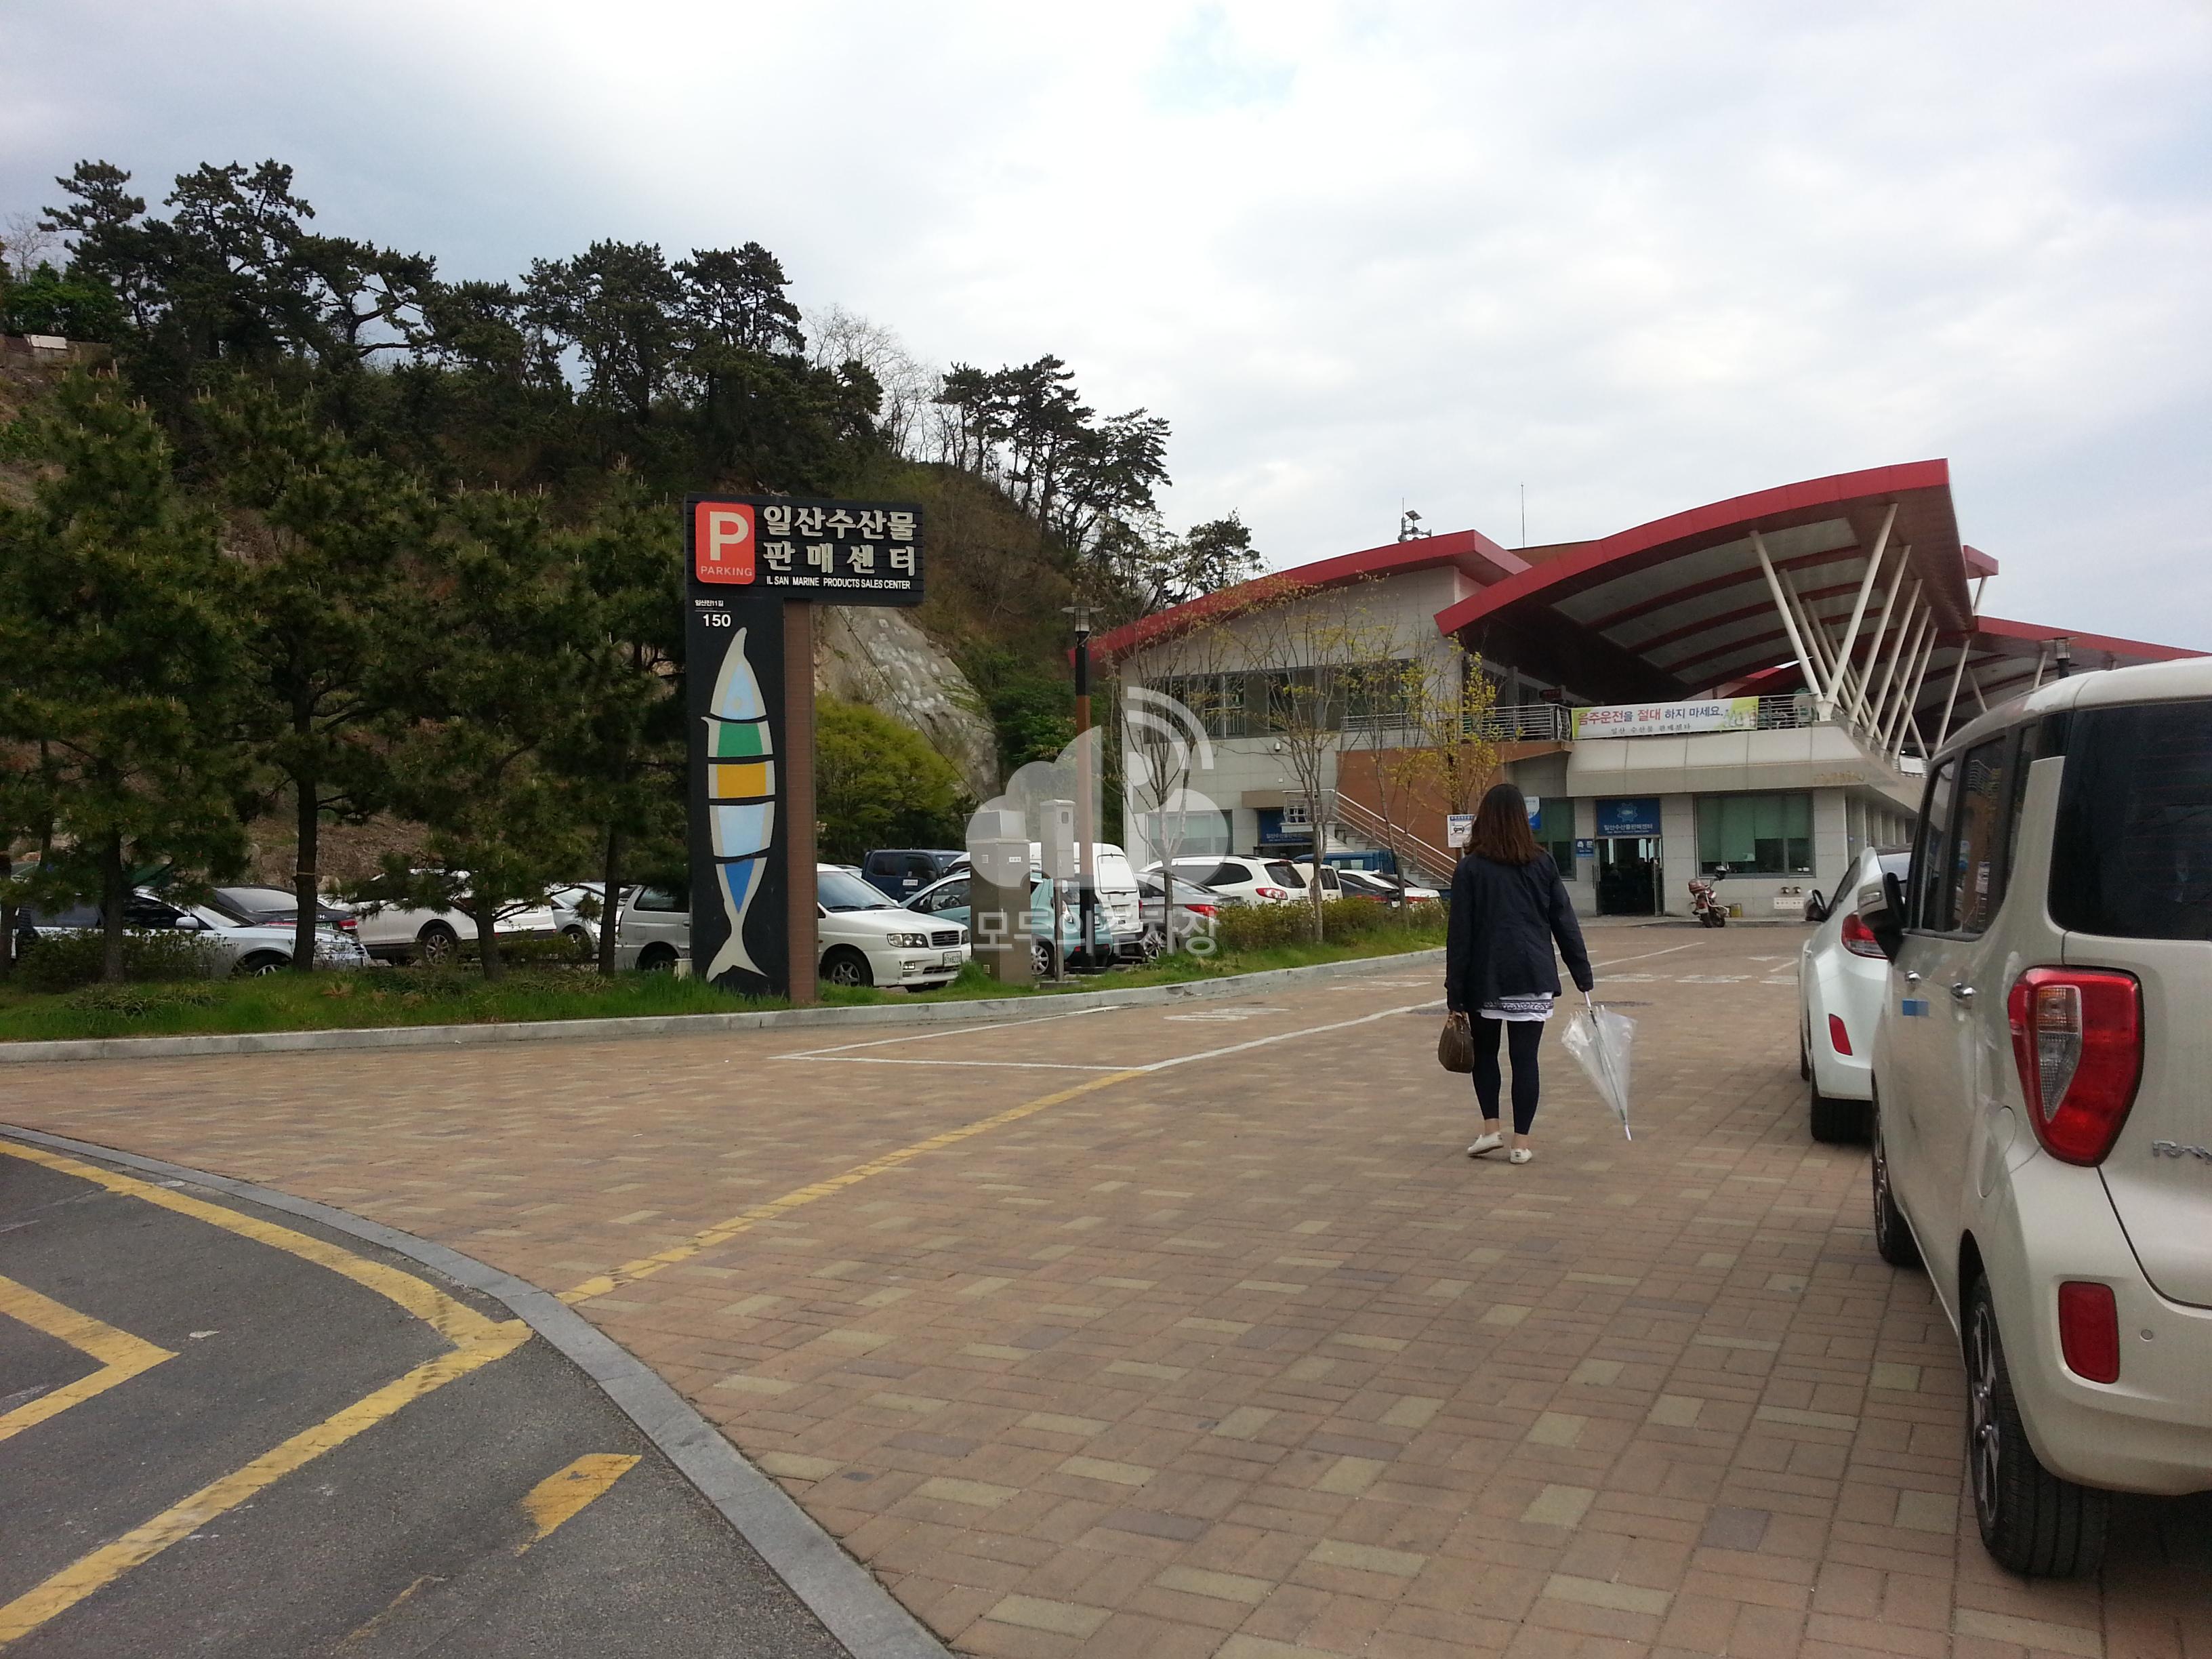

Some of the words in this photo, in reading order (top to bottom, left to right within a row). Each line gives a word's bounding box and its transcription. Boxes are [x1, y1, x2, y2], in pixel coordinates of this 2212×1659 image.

[763, 505, 917, 541] 일산수산물
[710, 511, 749, 561] P
[700, 565, 753, 576] PARKING
[792, 577, 819, 586] MARINE
[823, 577, 860, 588] PRODUCTS
[861, 579, 883, 589] SALES
[884, 579, 910, 590] CENTER
[703, 613, 731, 627] 150
[1578, 710, 1633, 726] 음주운전을
[1637, 708, 1661, 722] 절대
[1664, 708, 1685, 720] 하지
[1689, 706, 1723, 717] 마세요.
